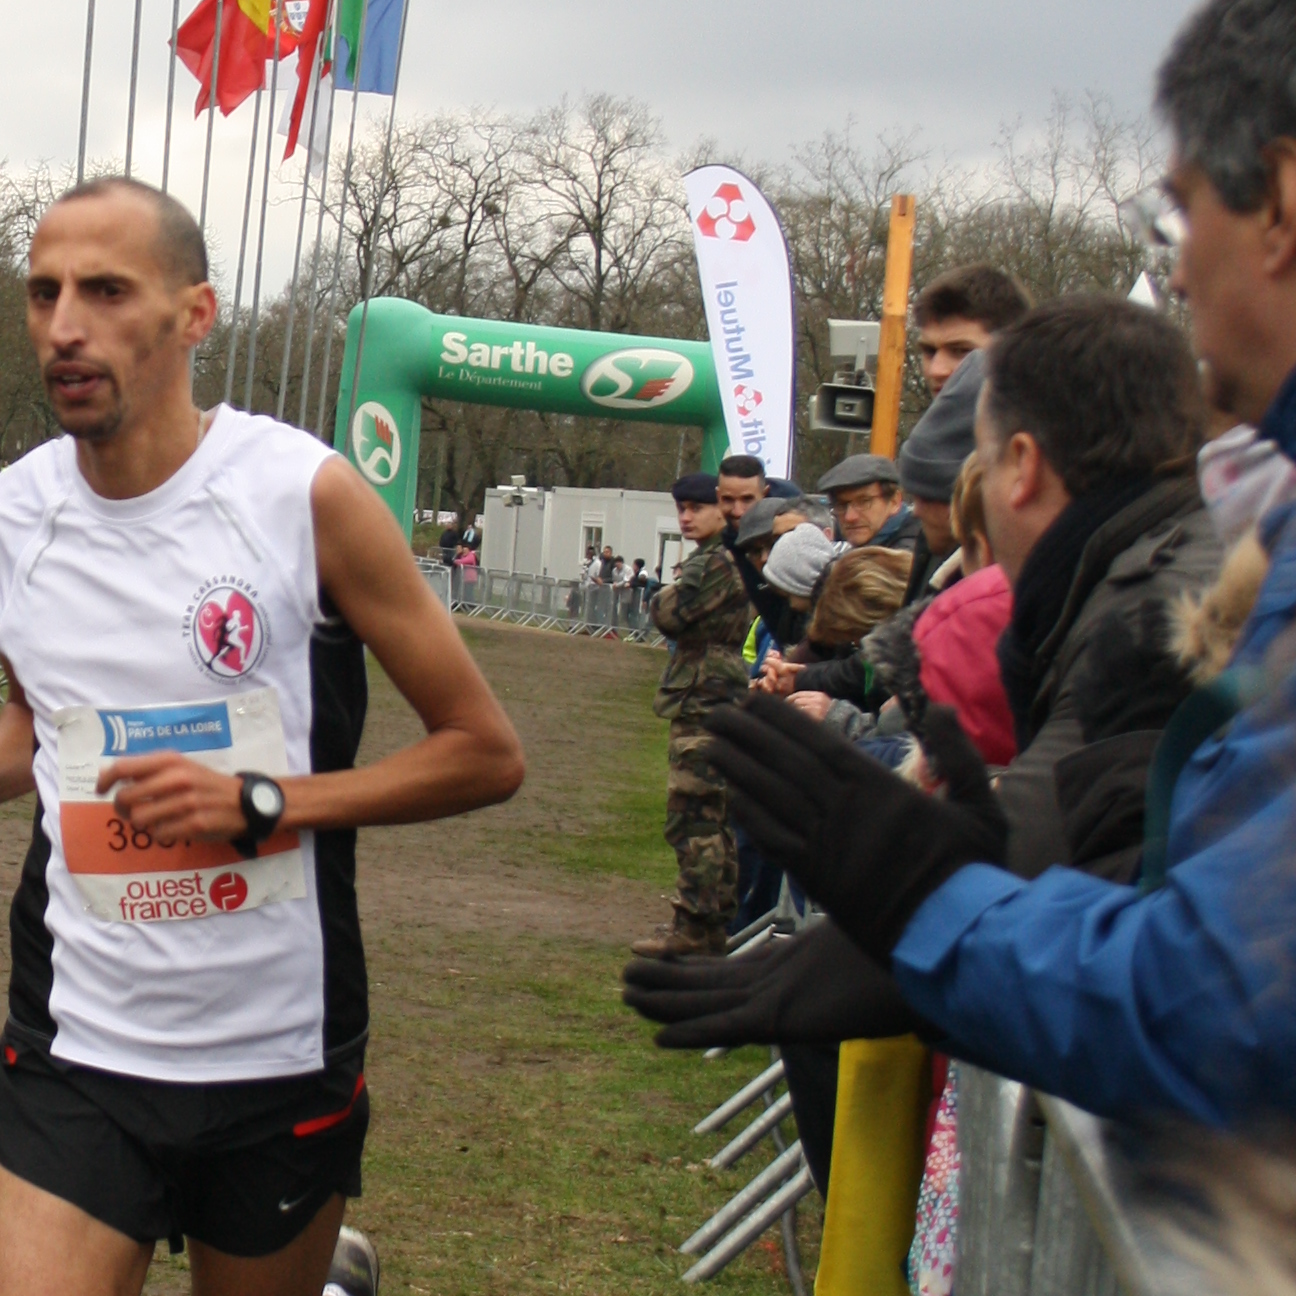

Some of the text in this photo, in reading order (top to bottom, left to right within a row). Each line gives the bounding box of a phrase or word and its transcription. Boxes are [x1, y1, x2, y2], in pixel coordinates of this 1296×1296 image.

[440, 331, 574, 377] Sarthe
[438, 365, 542, 391] Le Département
[127, 719, 222, 738] PAYS DE LA LOIRE
[126, 872, 204, 899] ouest
[118, 896, 208, 921] france
